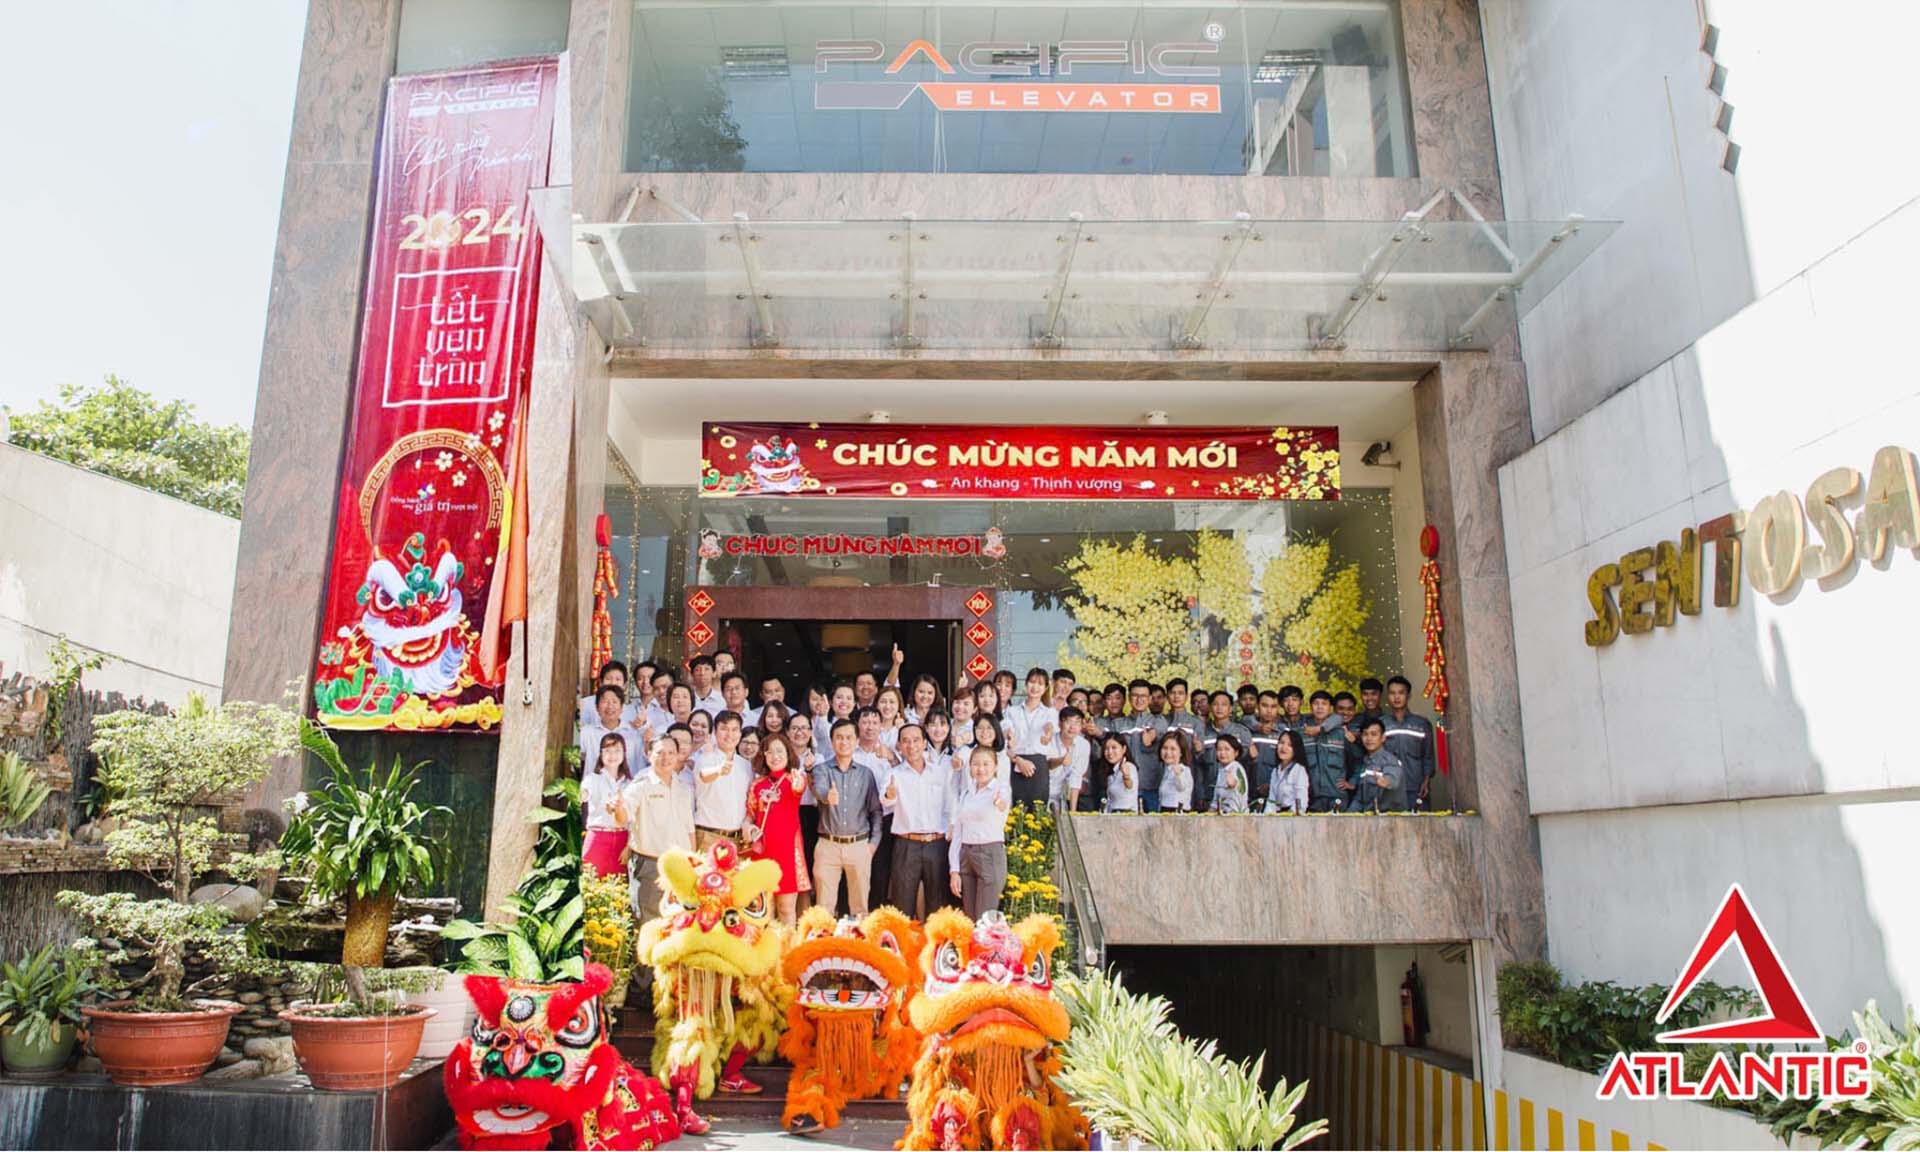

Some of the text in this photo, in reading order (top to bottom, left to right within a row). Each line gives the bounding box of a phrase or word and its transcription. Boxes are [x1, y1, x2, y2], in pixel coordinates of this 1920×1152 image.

[815, 39, 1221, 76] PACIFIC
[955, 89, 1209, 106] ELEVATOR
[400, 205, 525, 250] 2024
[833, 438, 1238, 468] CHÚC MỪNG NĂM MỚI
[951, 476, 973, 489] An
[975, 476, 1020, 491] khang
[1031, 476, 1073, 491] Thịnh
[1076, 479, 1123, 490] vượng
[1585, 446, 1920, 647] SENTOSA
